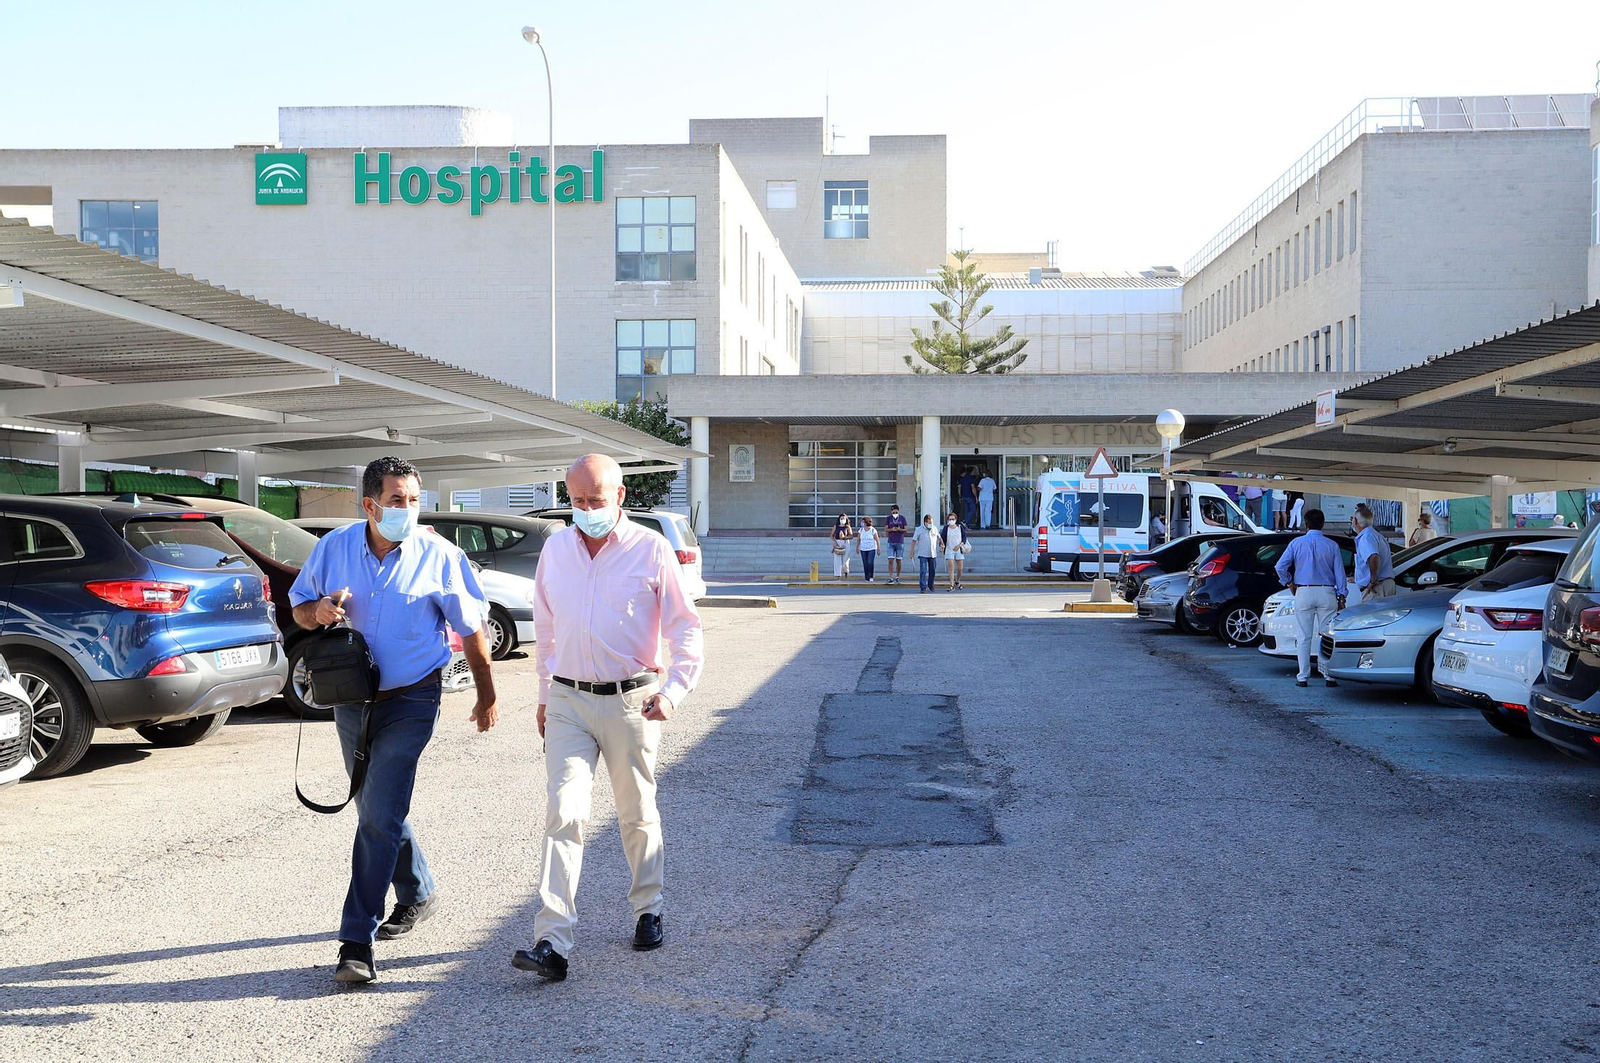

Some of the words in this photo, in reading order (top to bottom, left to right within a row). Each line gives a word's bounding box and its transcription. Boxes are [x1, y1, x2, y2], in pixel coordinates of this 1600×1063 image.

[354, 149, 604, 217] Hospital
[1052, 424, 1160, 446] EXTERNAS
[223, 602, 253, 611] KADJAR
[220, 651, 243, 666] 5168
